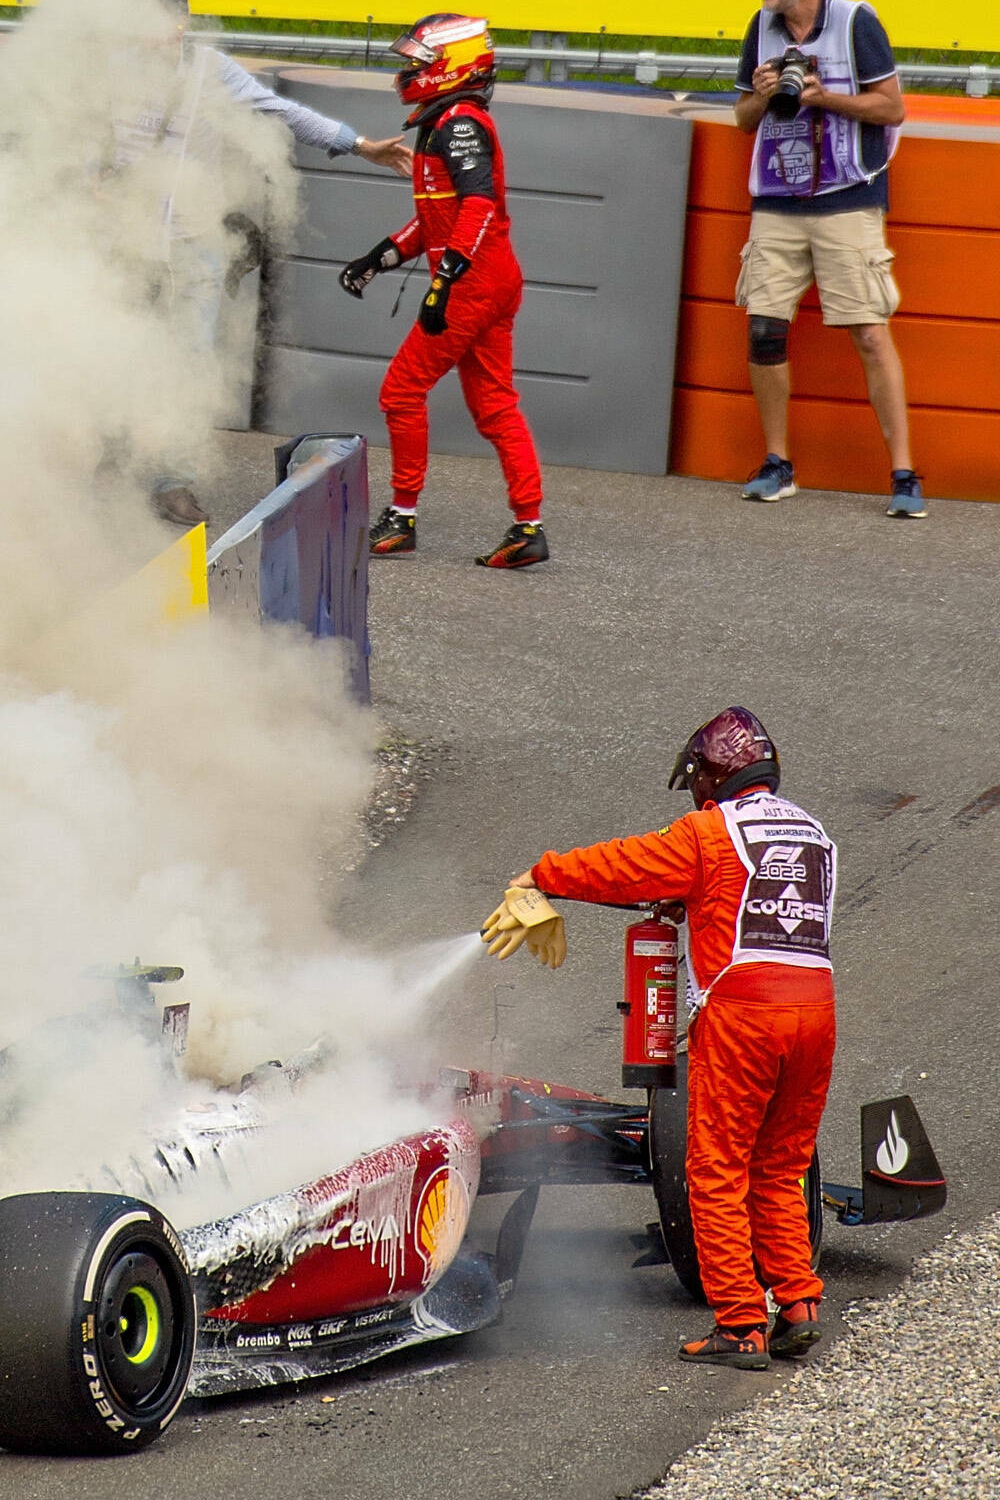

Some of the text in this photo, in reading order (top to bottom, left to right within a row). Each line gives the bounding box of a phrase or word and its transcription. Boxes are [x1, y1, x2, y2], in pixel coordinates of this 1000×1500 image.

[428, 72, 458, 85] VELAS
[775, 166, 814, 178] COURS
[755, 862, 807, 883] 2022
[746, 899, 824, 923] COURSE
[236, 1332, 281, 1348] brembo
[287, 1325, 315, 1341] NGK
[317, 1319, 350, 1337] SKF
[82, 1353, 126, 1433] ZERO
